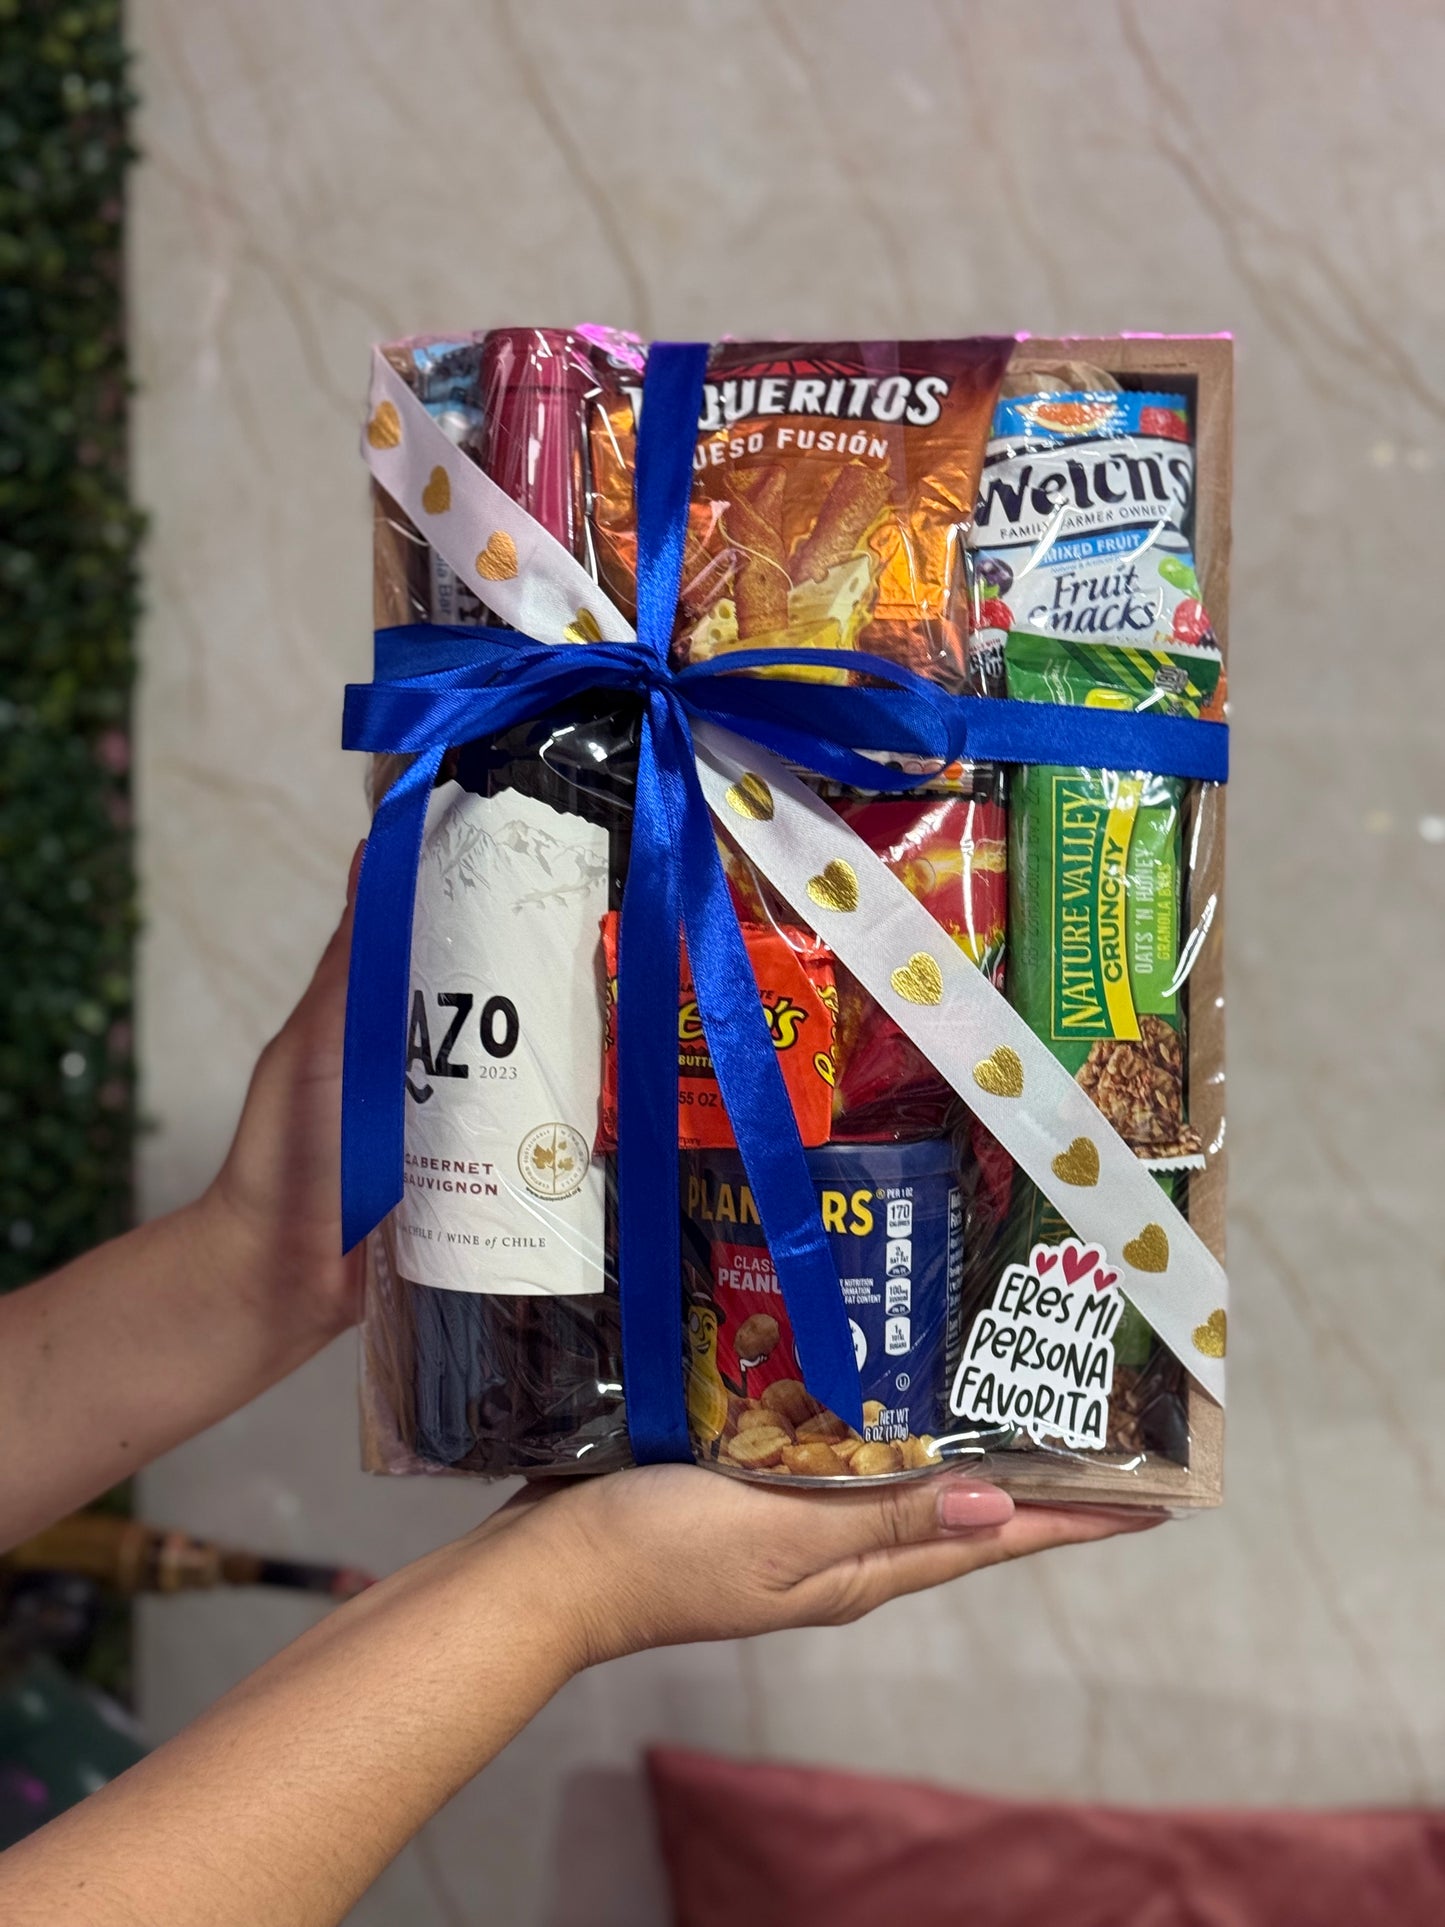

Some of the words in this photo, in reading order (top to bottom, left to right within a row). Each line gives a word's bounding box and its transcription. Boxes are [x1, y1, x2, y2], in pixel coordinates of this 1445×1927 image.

[619, 376, 950, 431] TQUERITOS
[692, 432, 764, 471] UESO
[776, 427, 889, 460] FUSIÓN
[1060, 509, 1114, 531] ARMER
[1118, 503, 1168, 520] OWNED
[1043, 541, 1094, 564] MIXED
[1096, 533, 1142, 553] FRUIT
[1053, 563, 1141, 610] Fruit
[1062, 787, 1107, 901] VALLEY
[1134, 846, 1154, 903] HONEY
[1101, 836, 1124, 984] CRUNCHY
[1156, 900, 1172, 961] GRANOLA
[1061, 906, 1107, 1030] NATURE
[1134, 931, 1154, 975] OATS
[406, 990, 520, 1080] AZO
[479, 1065, 518, 1080] 2023
[678, 1055, 713, 1069] BUTT
[697, 1092, 718, 1107] OZ
[405, 1153, 494, 1176] CABERNET
[404, 1173, 498, 1196] SAUVIGNON
[688, 1174, 875, 1238] PLANRS
[890, 1203, 910, 1220] 170
[447, 1232, 480, 1246] WINE
[485, 1236, 498, 1249] of
[502, 1236, 547, 1249] CHILE
[716, 1267, 783, 1295] PEANU
[733, 1254, 776, 1274] CLAS
[1074, 1293, 1118, 1339] MI
[879, 1410, 896, 1426] NET
[895, 1407, 910, 1424] WT
[955, 1365, 1102, 1442] FAVORITA
[864, 1427, 872, 1442] 6
[872, 1425, 884, 1442] OZ
